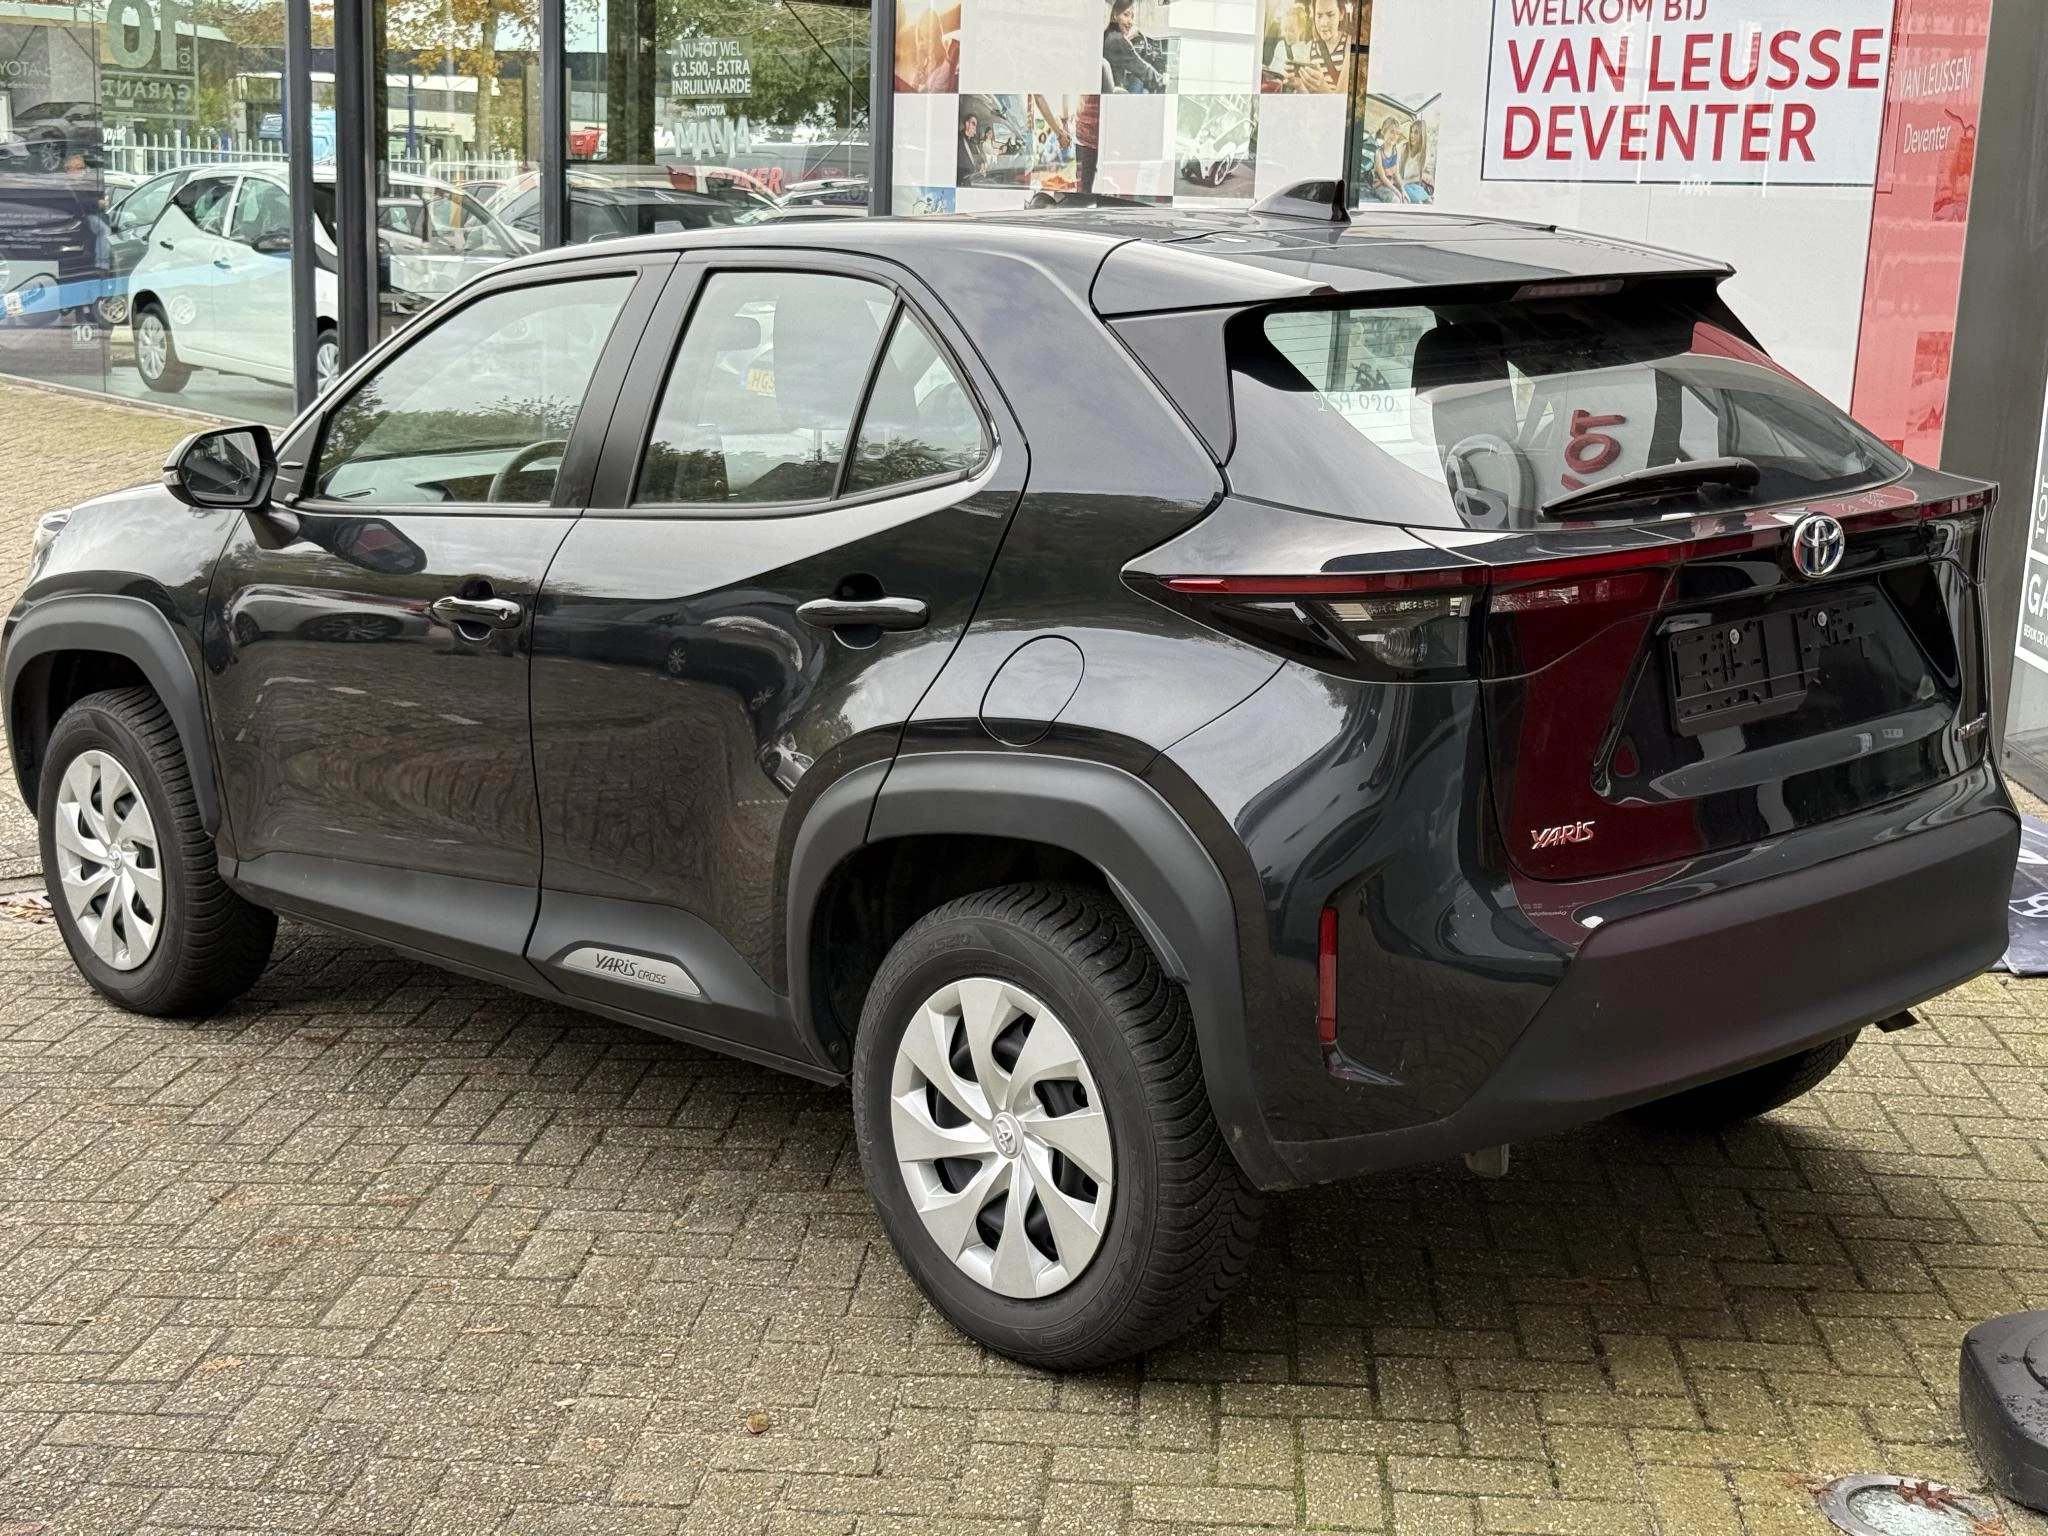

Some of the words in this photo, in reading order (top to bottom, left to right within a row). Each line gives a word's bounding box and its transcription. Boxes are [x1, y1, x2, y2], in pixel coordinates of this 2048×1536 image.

[680, 44, 696, 58] NU
[698, 42, 718, 57] TOT
[720, 41, 742, 56] WEL
[1507, 36, 1628, 95] VAN
[1648, 28, 1884, 93] LEUSSE
[672, 78, 751, 95] INRUILWAARDE
[1899, 67, 1923, 98] VAN
[1922, 55, 1972, 96] LEUSSEN
[695, 104, 726, 116] TOYOTA
[674, 115, 752, 160] MANIA
[1503, 103, 1817, 163] DEVENTER
[1903, 122, 1952, 154] Deventer
[637, 969, 667, 985] CROSS
